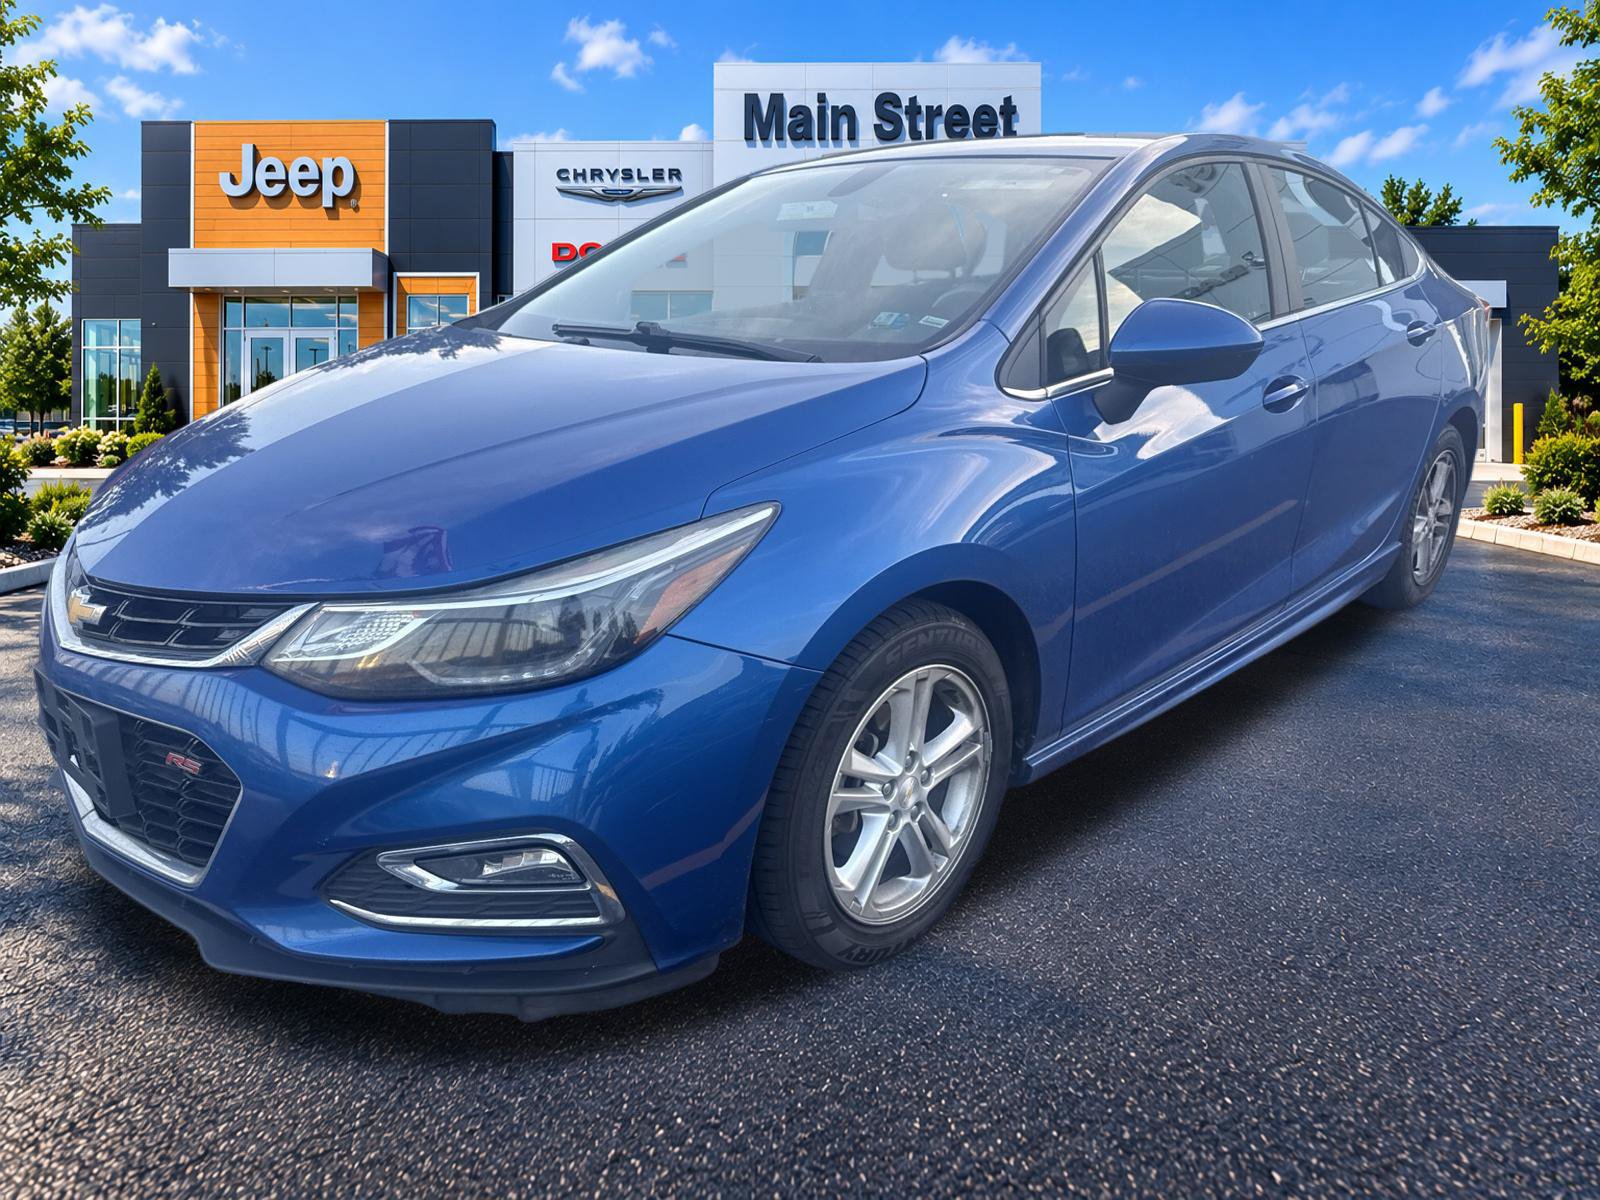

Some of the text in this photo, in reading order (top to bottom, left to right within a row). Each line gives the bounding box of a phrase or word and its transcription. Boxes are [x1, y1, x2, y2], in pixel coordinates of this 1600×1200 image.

[744, 91, 1018, 142] Main Street
[218, 143, 355, 208] Jeep
[556, 168, 683, 182] CHRYSLER
[165, 752, 202, 775] RS
